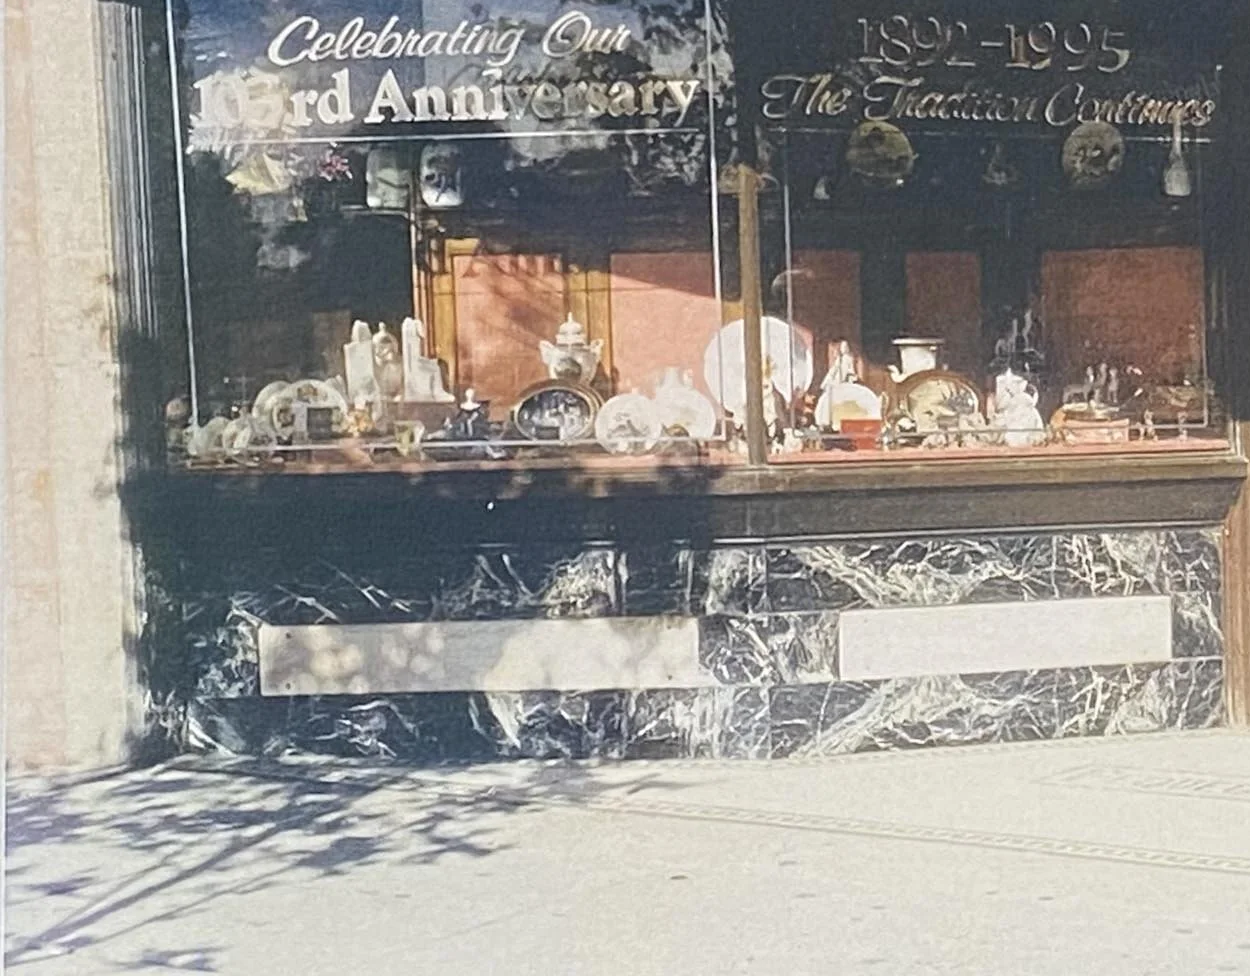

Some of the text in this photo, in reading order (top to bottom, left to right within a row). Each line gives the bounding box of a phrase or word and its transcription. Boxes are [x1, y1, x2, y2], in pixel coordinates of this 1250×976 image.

[267, 10, 633, 66] Celebrating Our
[857, 14, 1133, 74] 1892-1995
[362, 68, 701, 128] Anniversary
[760, 72, 1217, 127] The Tradition Continues
